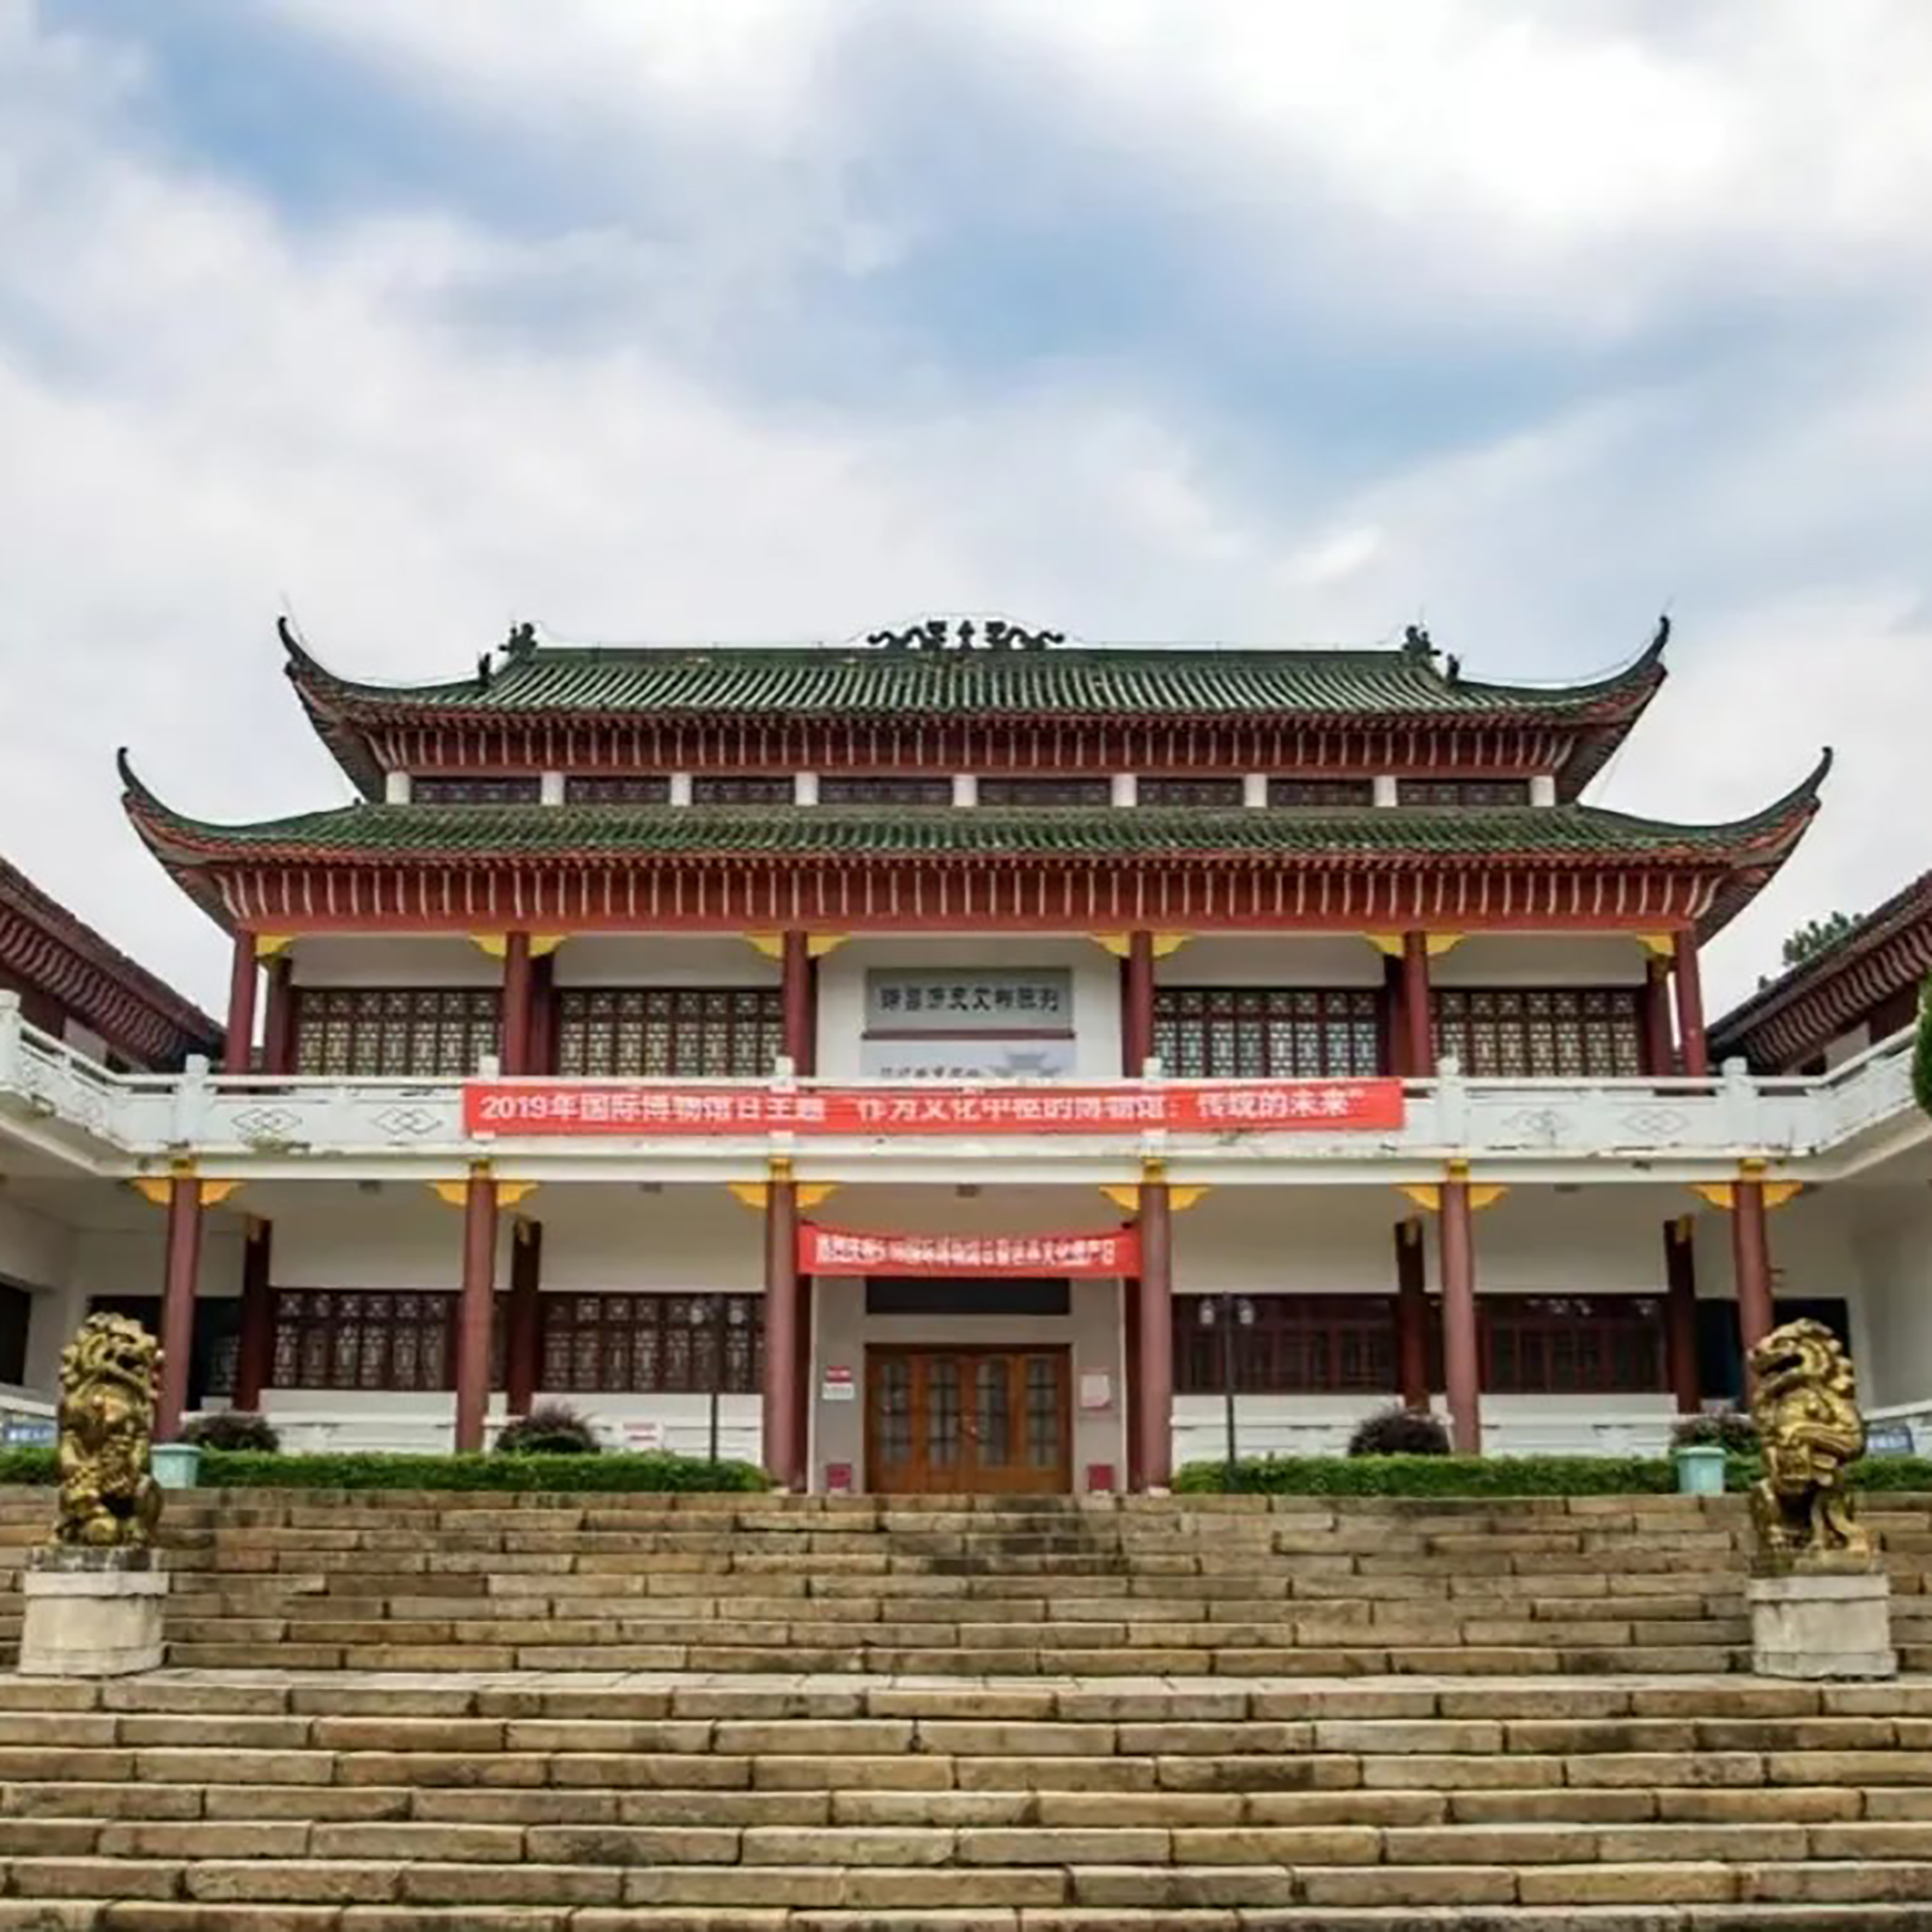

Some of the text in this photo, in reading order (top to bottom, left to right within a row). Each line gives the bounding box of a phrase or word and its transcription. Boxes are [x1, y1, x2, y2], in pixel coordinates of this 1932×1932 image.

[479, 1094, 825, 1122] 2019年国际博物馆日主题
